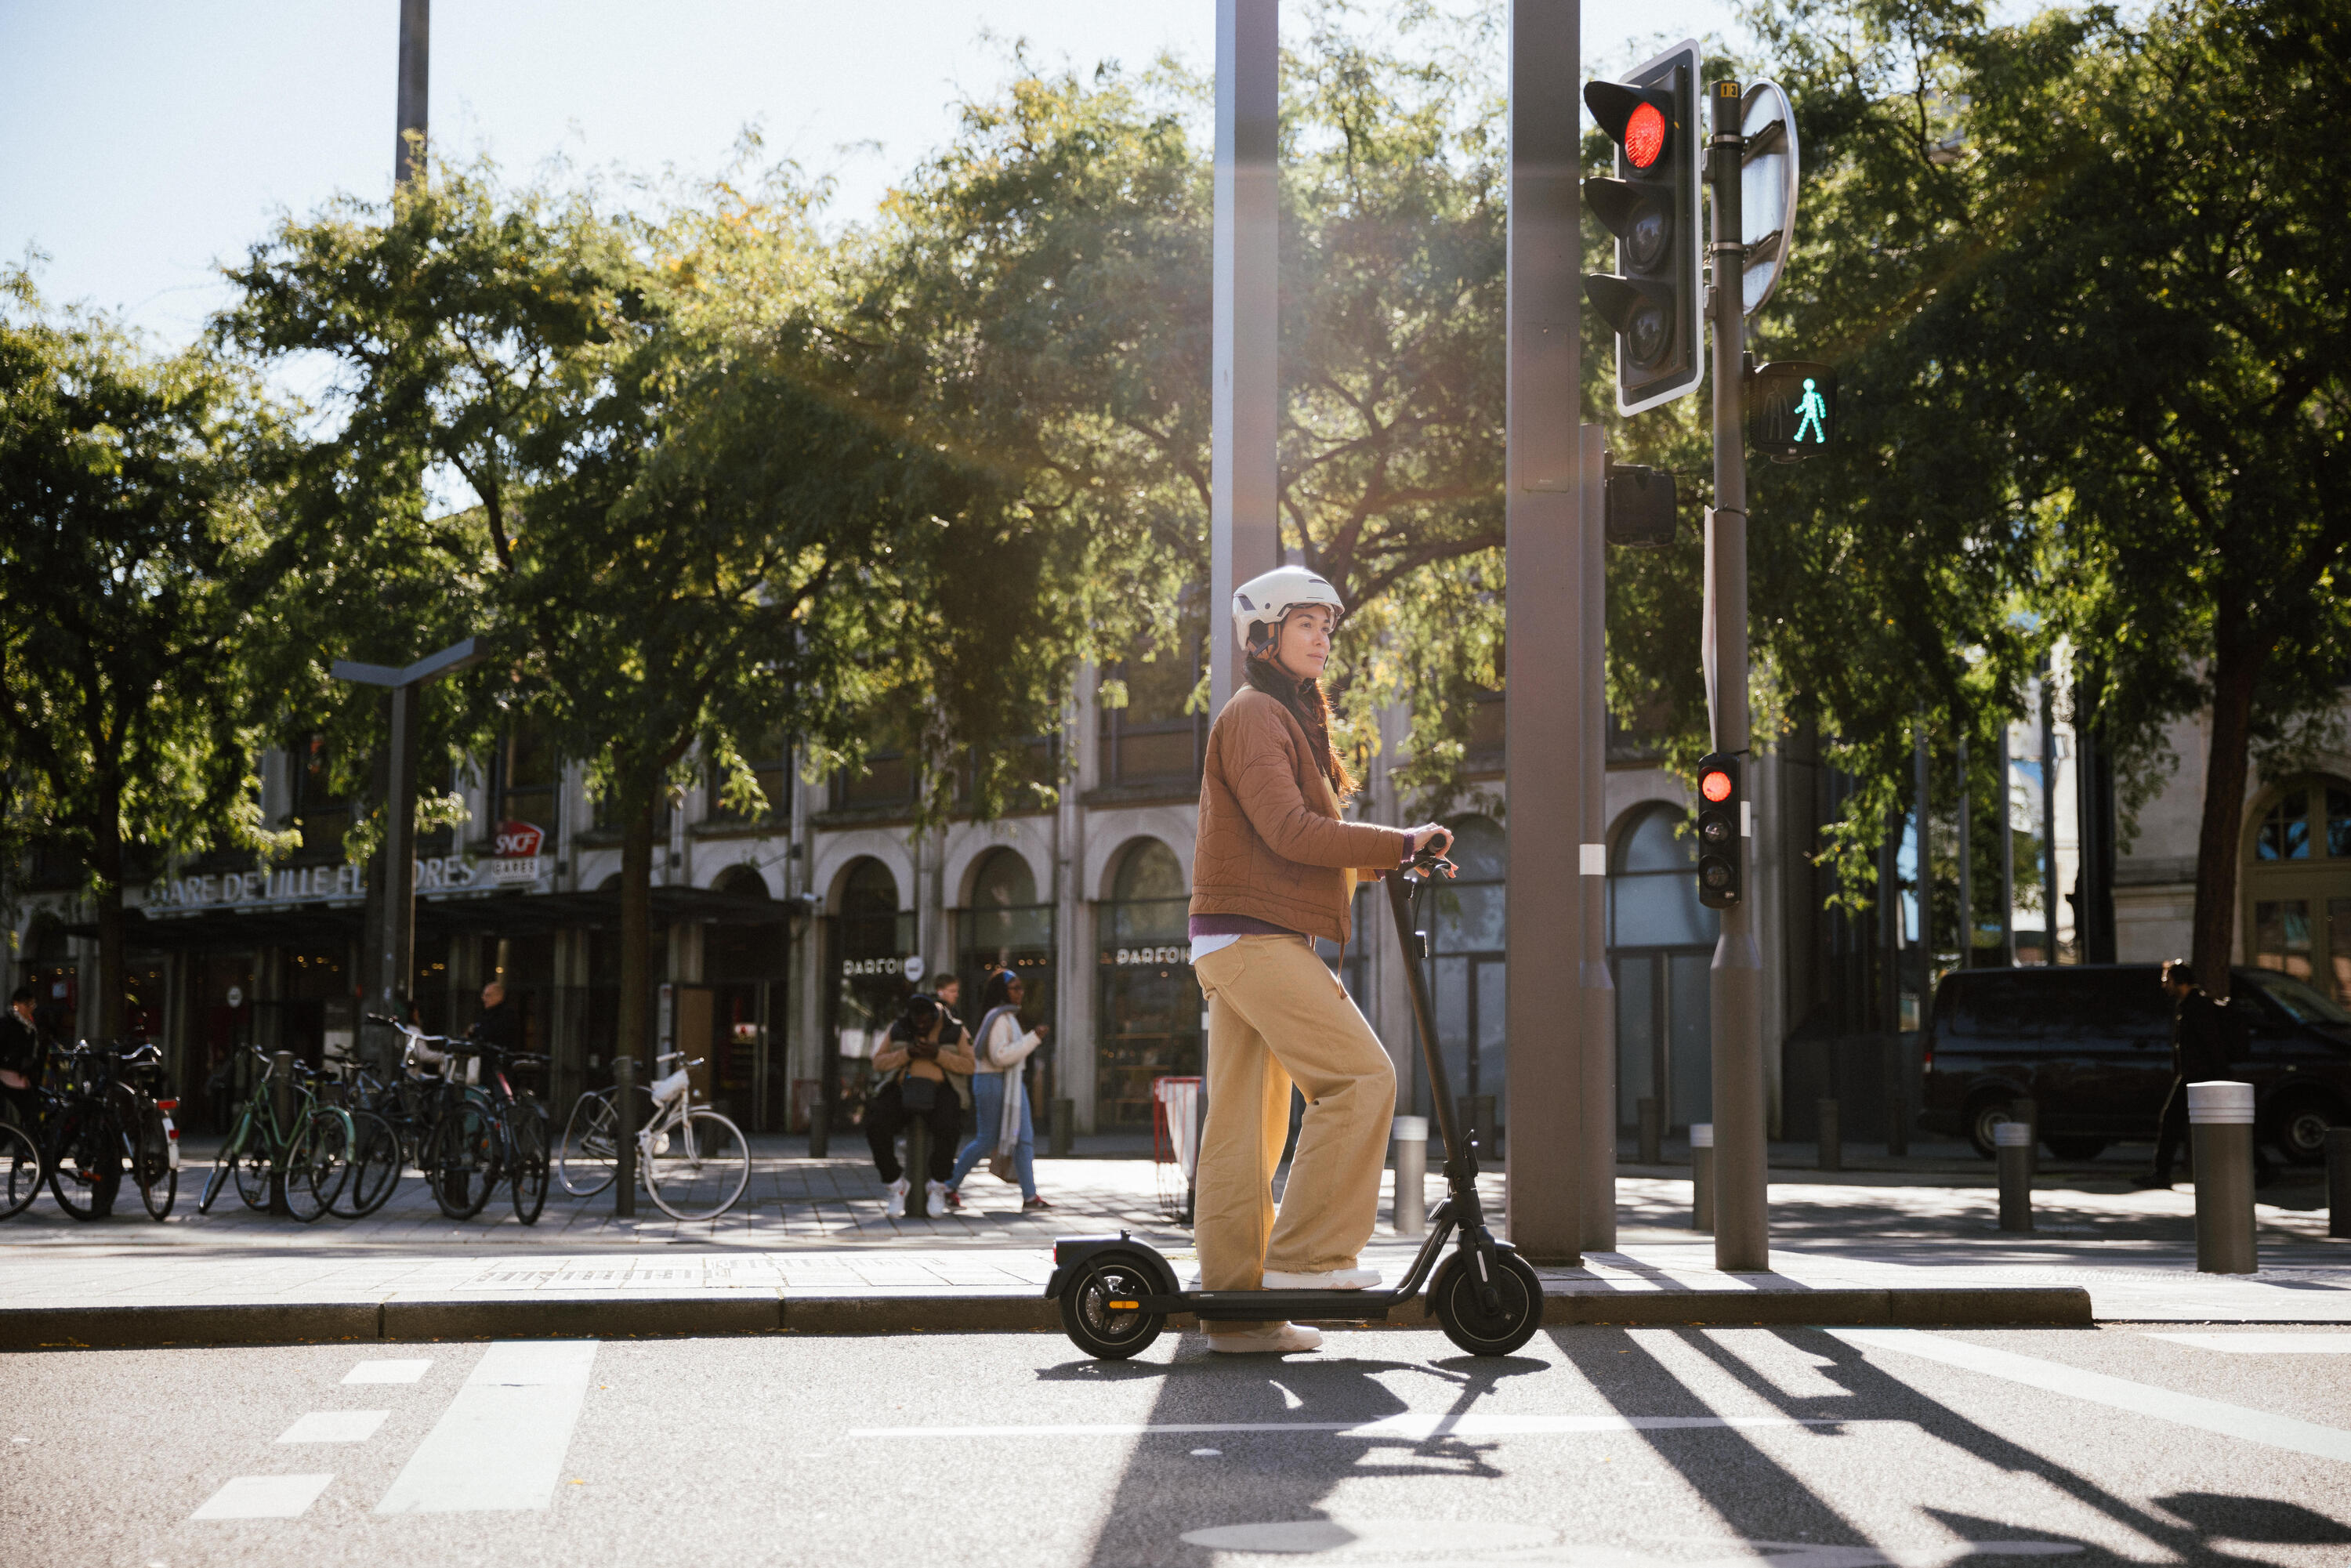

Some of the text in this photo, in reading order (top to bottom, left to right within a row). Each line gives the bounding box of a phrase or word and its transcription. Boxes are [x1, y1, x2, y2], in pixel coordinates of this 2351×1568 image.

[494, 832, 537, 854] SNCF
[223, 871, 259, 901] DE
[265, 865, 330, 898] LILLE
[842, 958, 904, 976] PARFOI
